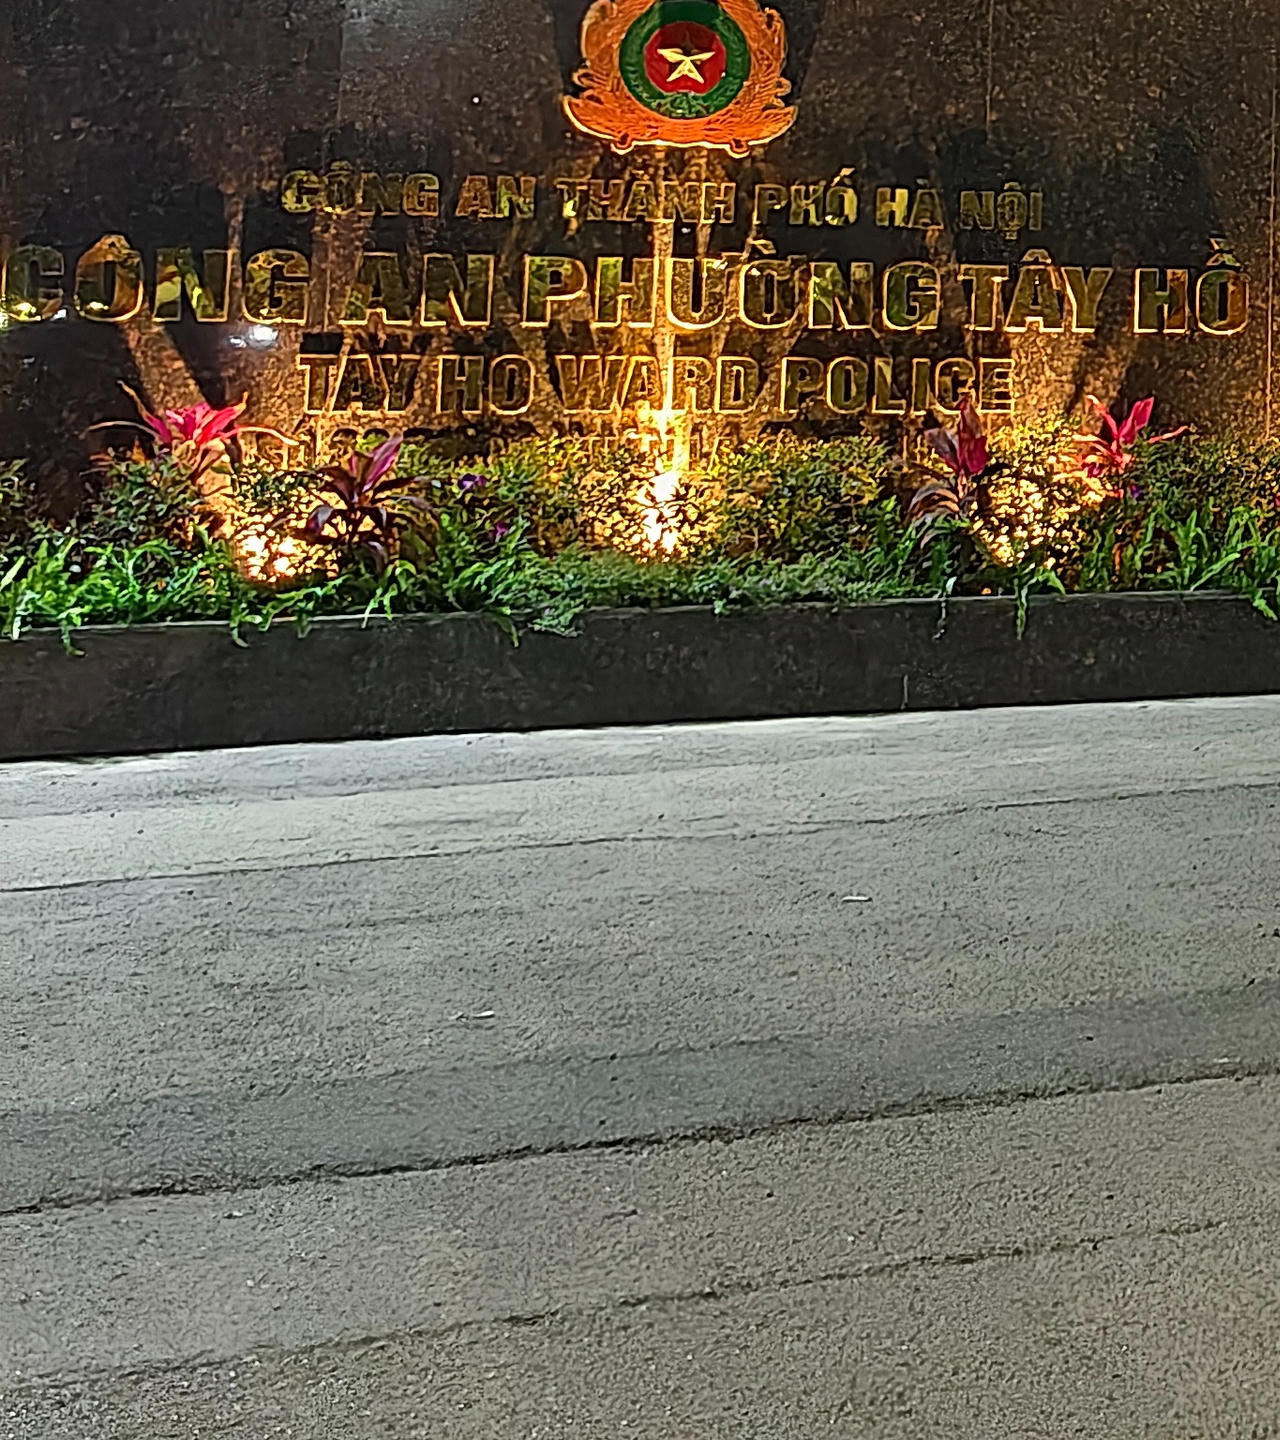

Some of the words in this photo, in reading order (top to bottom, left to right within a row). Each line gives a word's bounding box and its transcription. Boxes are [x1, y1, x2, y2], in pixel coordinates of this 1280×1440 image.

[281, 160, 440, 218] CÔNG
[455, 174, 538, 219] AN
[752, 166, 859, 228] PHỐ
[875, 177, 947, 231] HÀ
[958, 181, 1045, 241] NỘI
[2, 233, 312, 325] CÔNG
[339, 252, 496, 327] AN
[519, 237, 941, 330] PHƯỜNG
[957, 248, 1115, 334] TÂY
[1132, 232, 1252, 337] HỒ
[296, 353, 422, 416] TAY
[436, 353, 536, 417] HO
[553, 355, 760, 416] WARD
[779, 355, 1016, 416] POLICE
